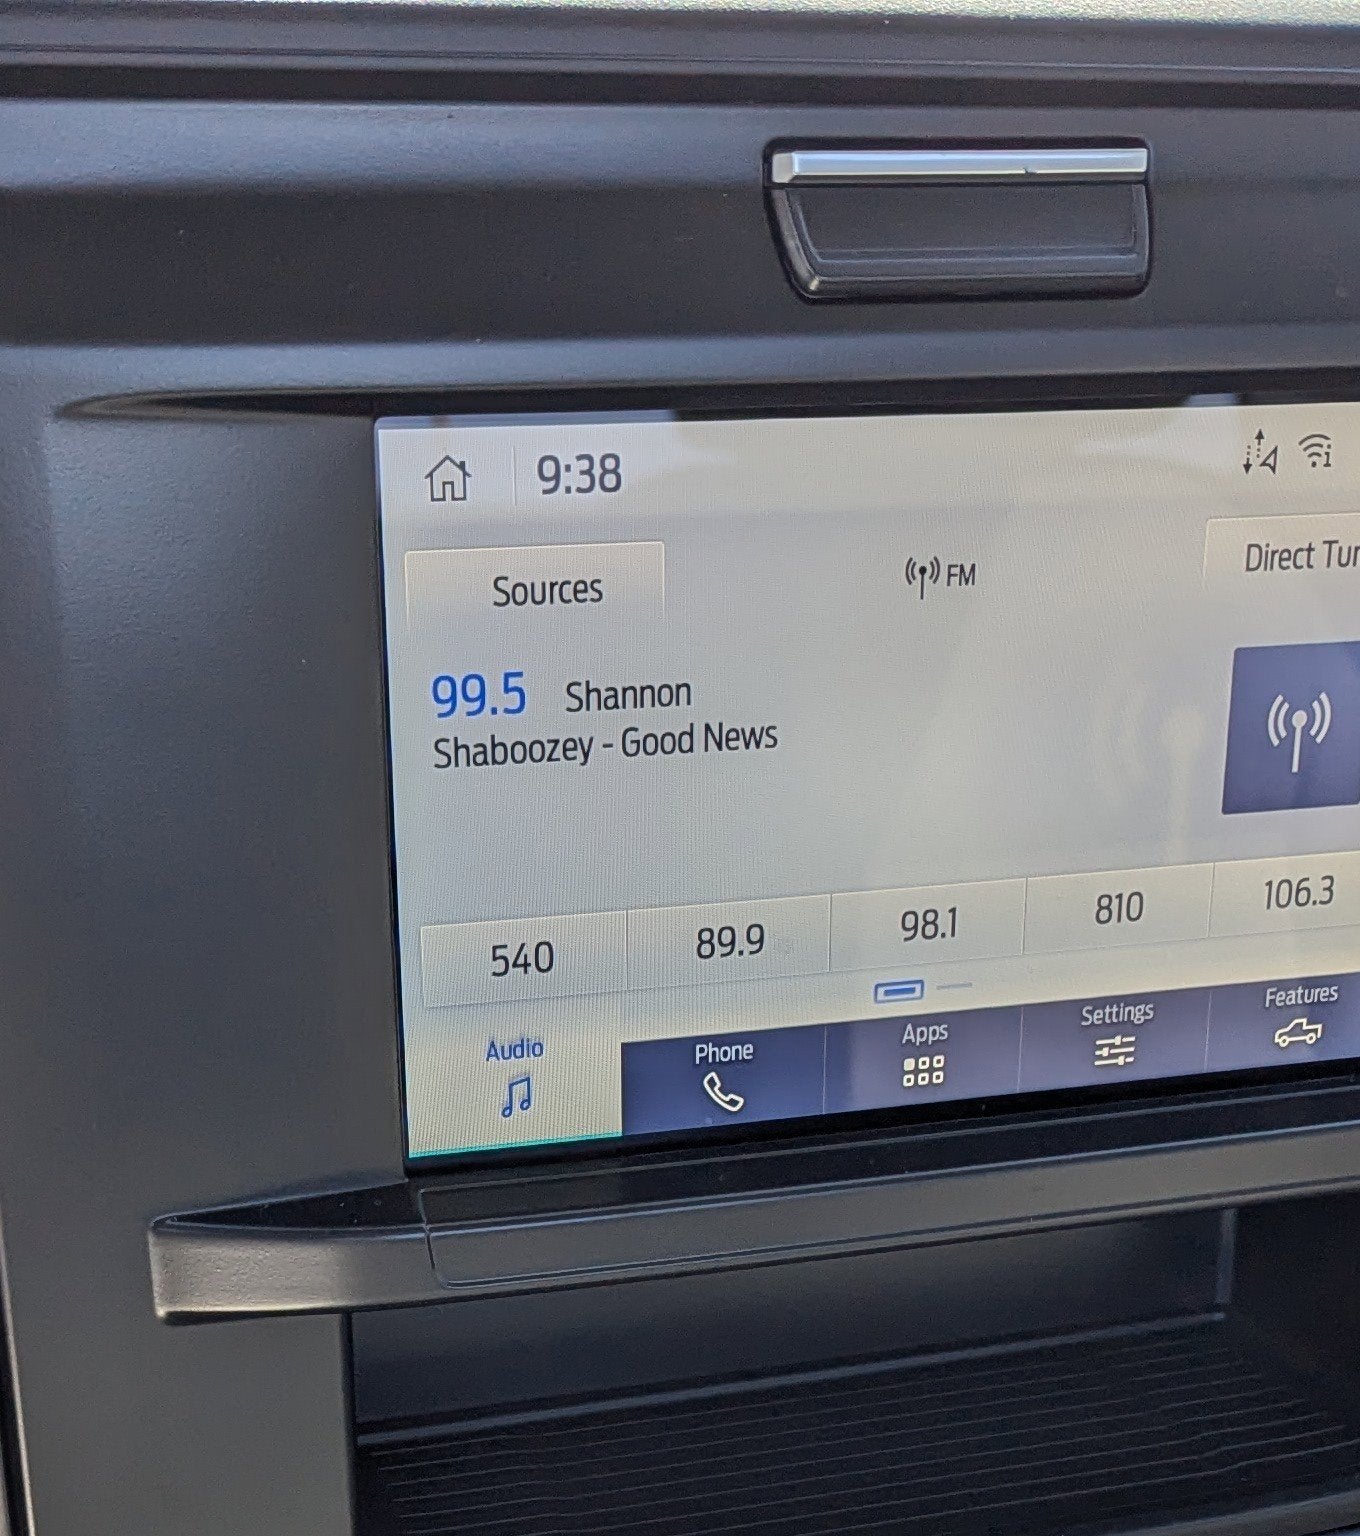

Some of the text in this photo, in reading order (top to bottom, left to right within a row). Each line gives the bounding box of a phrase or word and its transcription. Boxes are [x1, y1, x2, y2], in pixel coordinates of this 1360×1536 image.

[536, 452, 623, 496] 9:38
[1244, 542, 1316, 572] Direct
[492, 574, 604, 608] Sources
[946, 562, 977, 588] FM
[431, 671, 692, 719] 99.5 Shannon
[432, 734, 595, 770] Shaboozey
[620, 722, 695, 760] Good
[703, 721, 779, 754] News
[1094, 891, 1145, 926] 810
[1264, 874, 1336, 912] 106.3
[900, 906, 958, 942] 98.1
[695, 923, 766, 961] 89.9
[490, 941, 555, 979] 540
[1265, 982, 1339, 1009] Features
[1081, 999, 1155, 1028] Settings
[485, 1036, 545, 1063] Audio
[902, 1020, 949, 1046] Apps
[695, 1038, 754, 1064] Phone
